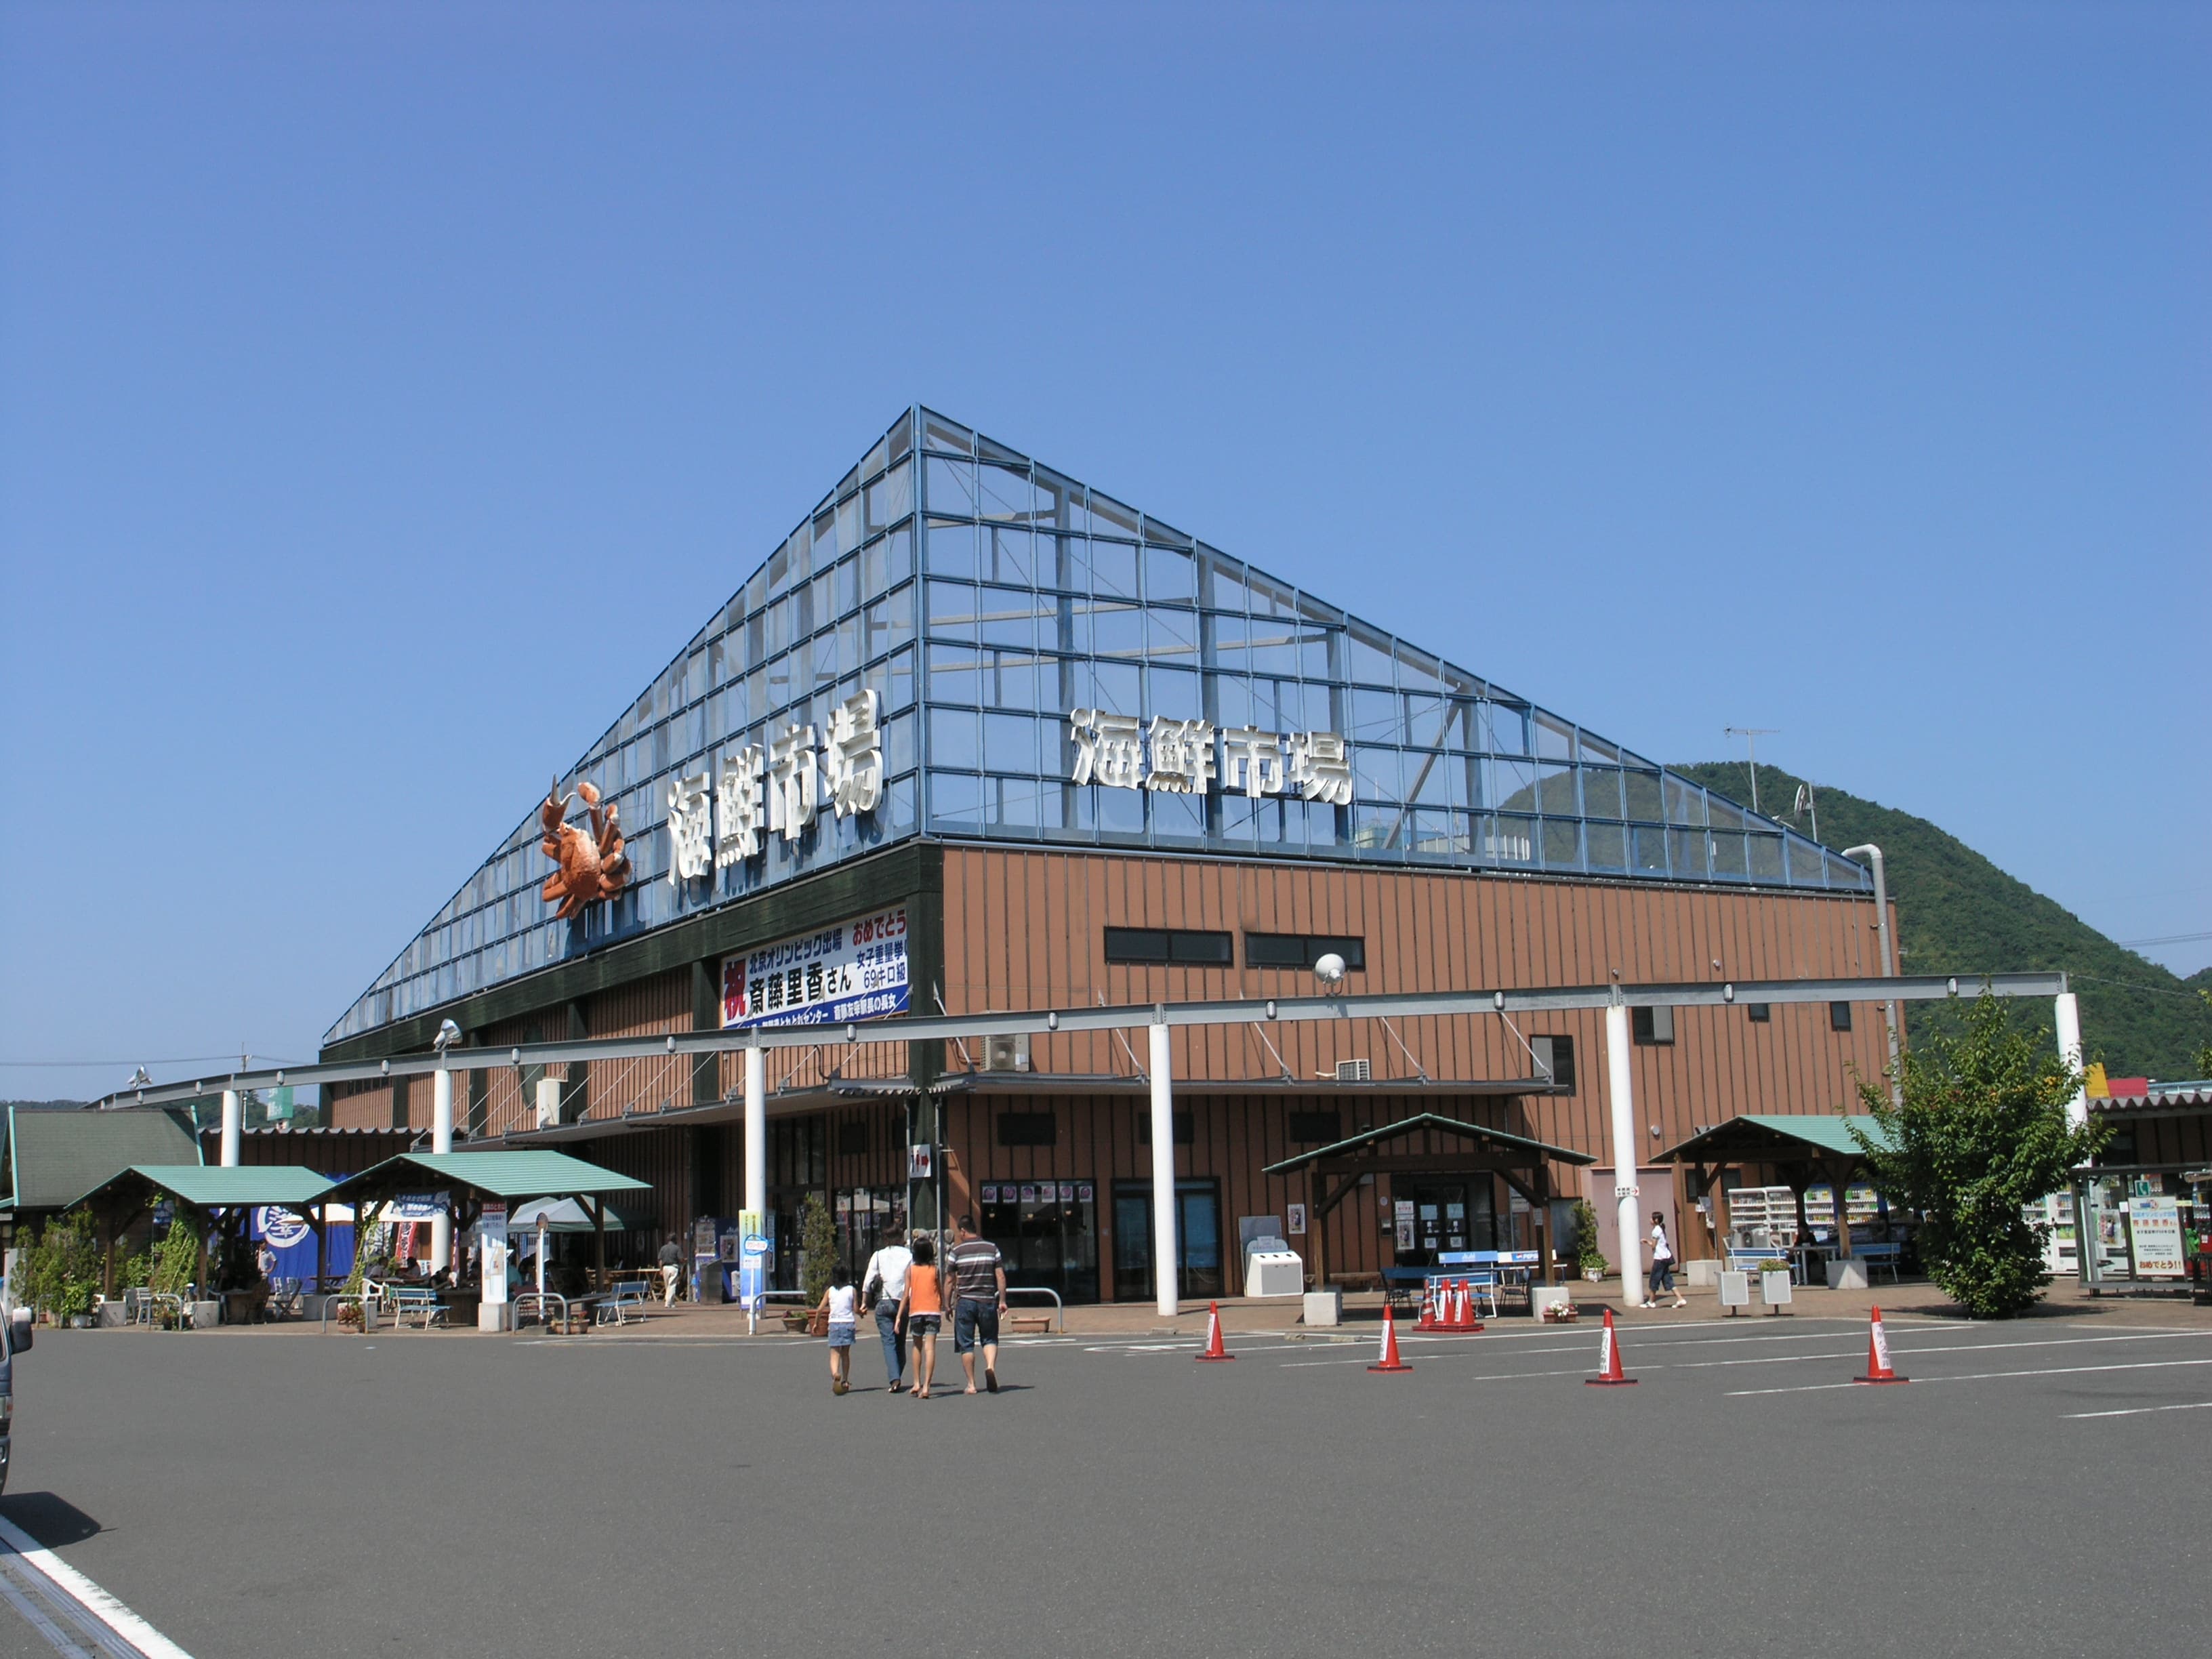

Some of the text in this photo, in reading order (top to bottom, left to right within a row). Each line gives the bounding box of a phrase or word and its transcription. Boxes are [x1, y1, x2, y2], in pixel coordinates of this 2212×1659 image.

[1071, 708, 1353, 806] 海鮮市場
[667, 689, 883, 886] 海鮮市場
[750, 928, 842, 975] 北京オリンピック出場
[853, 909, 906, 946] おめでとう
[724, 958, 746, 1021] 祝
[864, 962, 905, 988] 69キロ級
